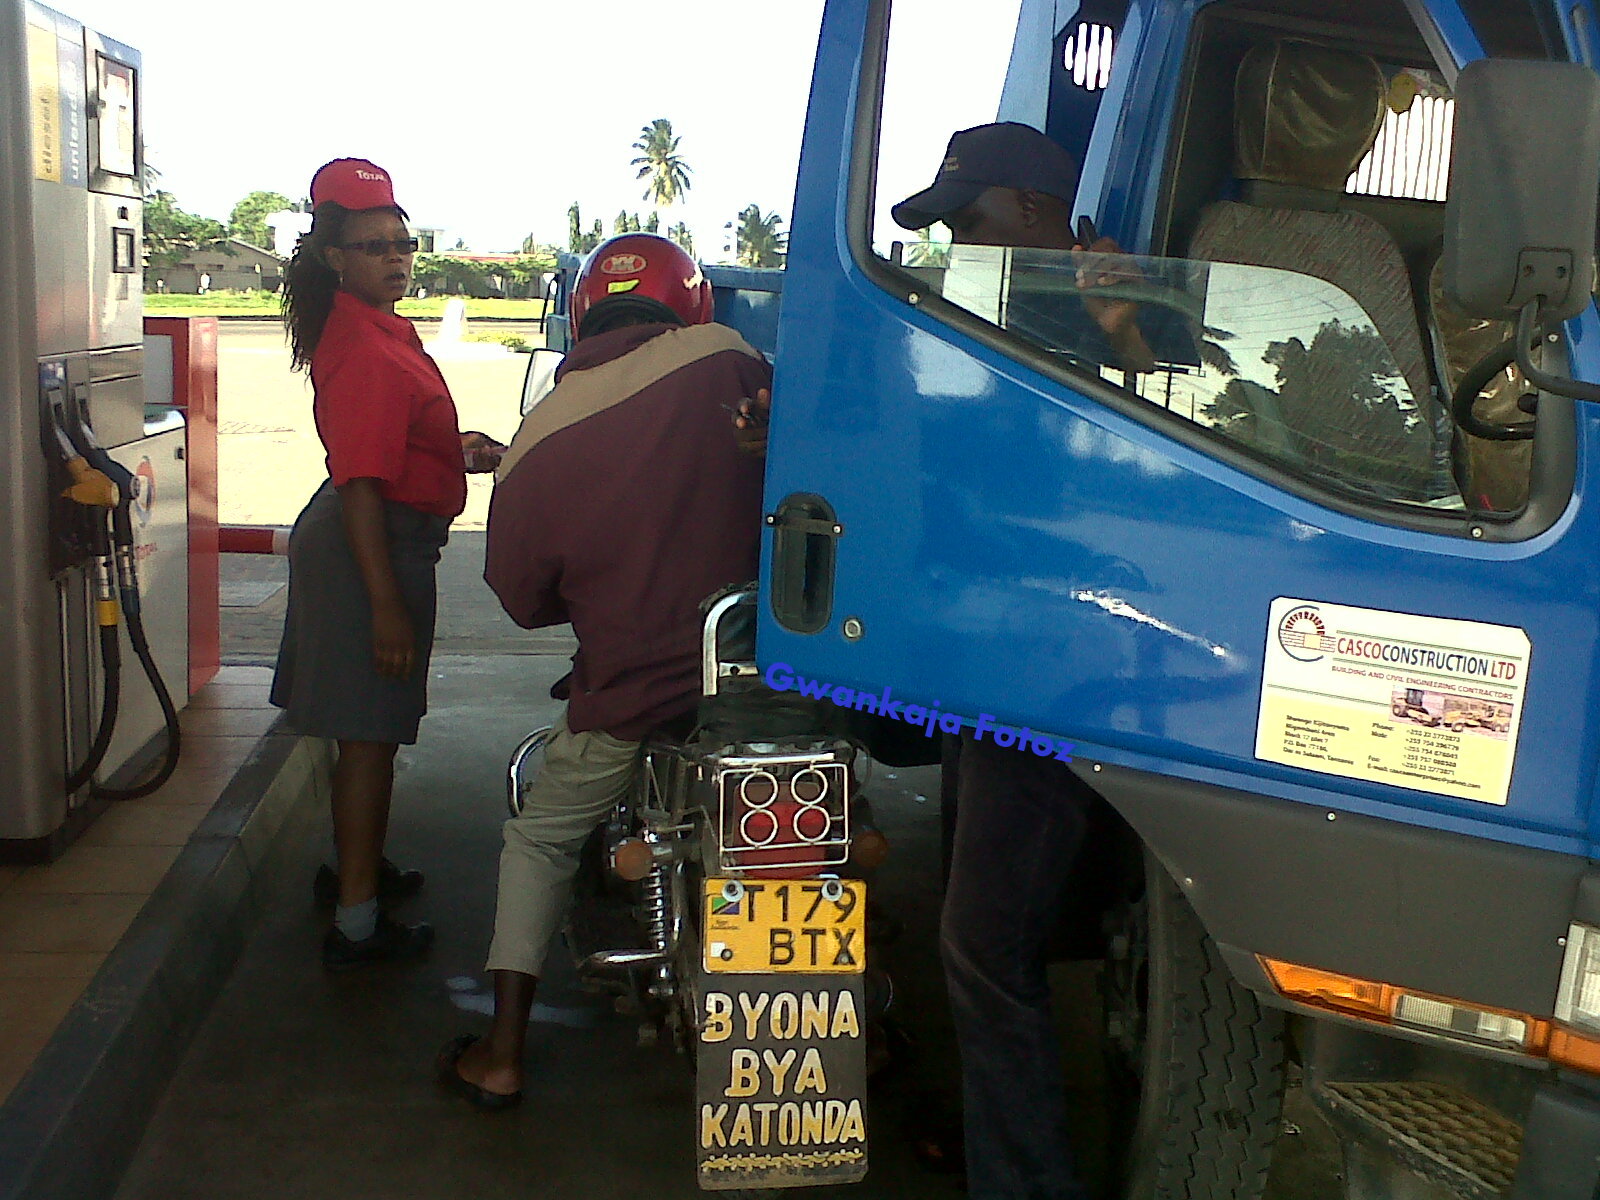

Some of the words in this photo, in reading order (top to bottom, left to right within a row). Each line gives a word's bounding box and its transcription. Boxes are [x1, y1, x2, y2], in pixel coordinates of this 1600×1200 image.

[1331, 665, 1366, 677] BUILDING
[1368, 671, 1385, 680] AND
[1386, 674, 1404, 683] CIVIL
[1406, 677, 1457, 692] ENGINEERING
[1457, 685, 1513, 701] CONTRACTORS
[1490, 660, 1516, 680] LTD
[769, 928, 857, 966] BTX
[700, 990, 860, 1042] BYONA
[723, 1047, 828, 1098] BYA
[701, 1098, 866, 1149] KATONDA
